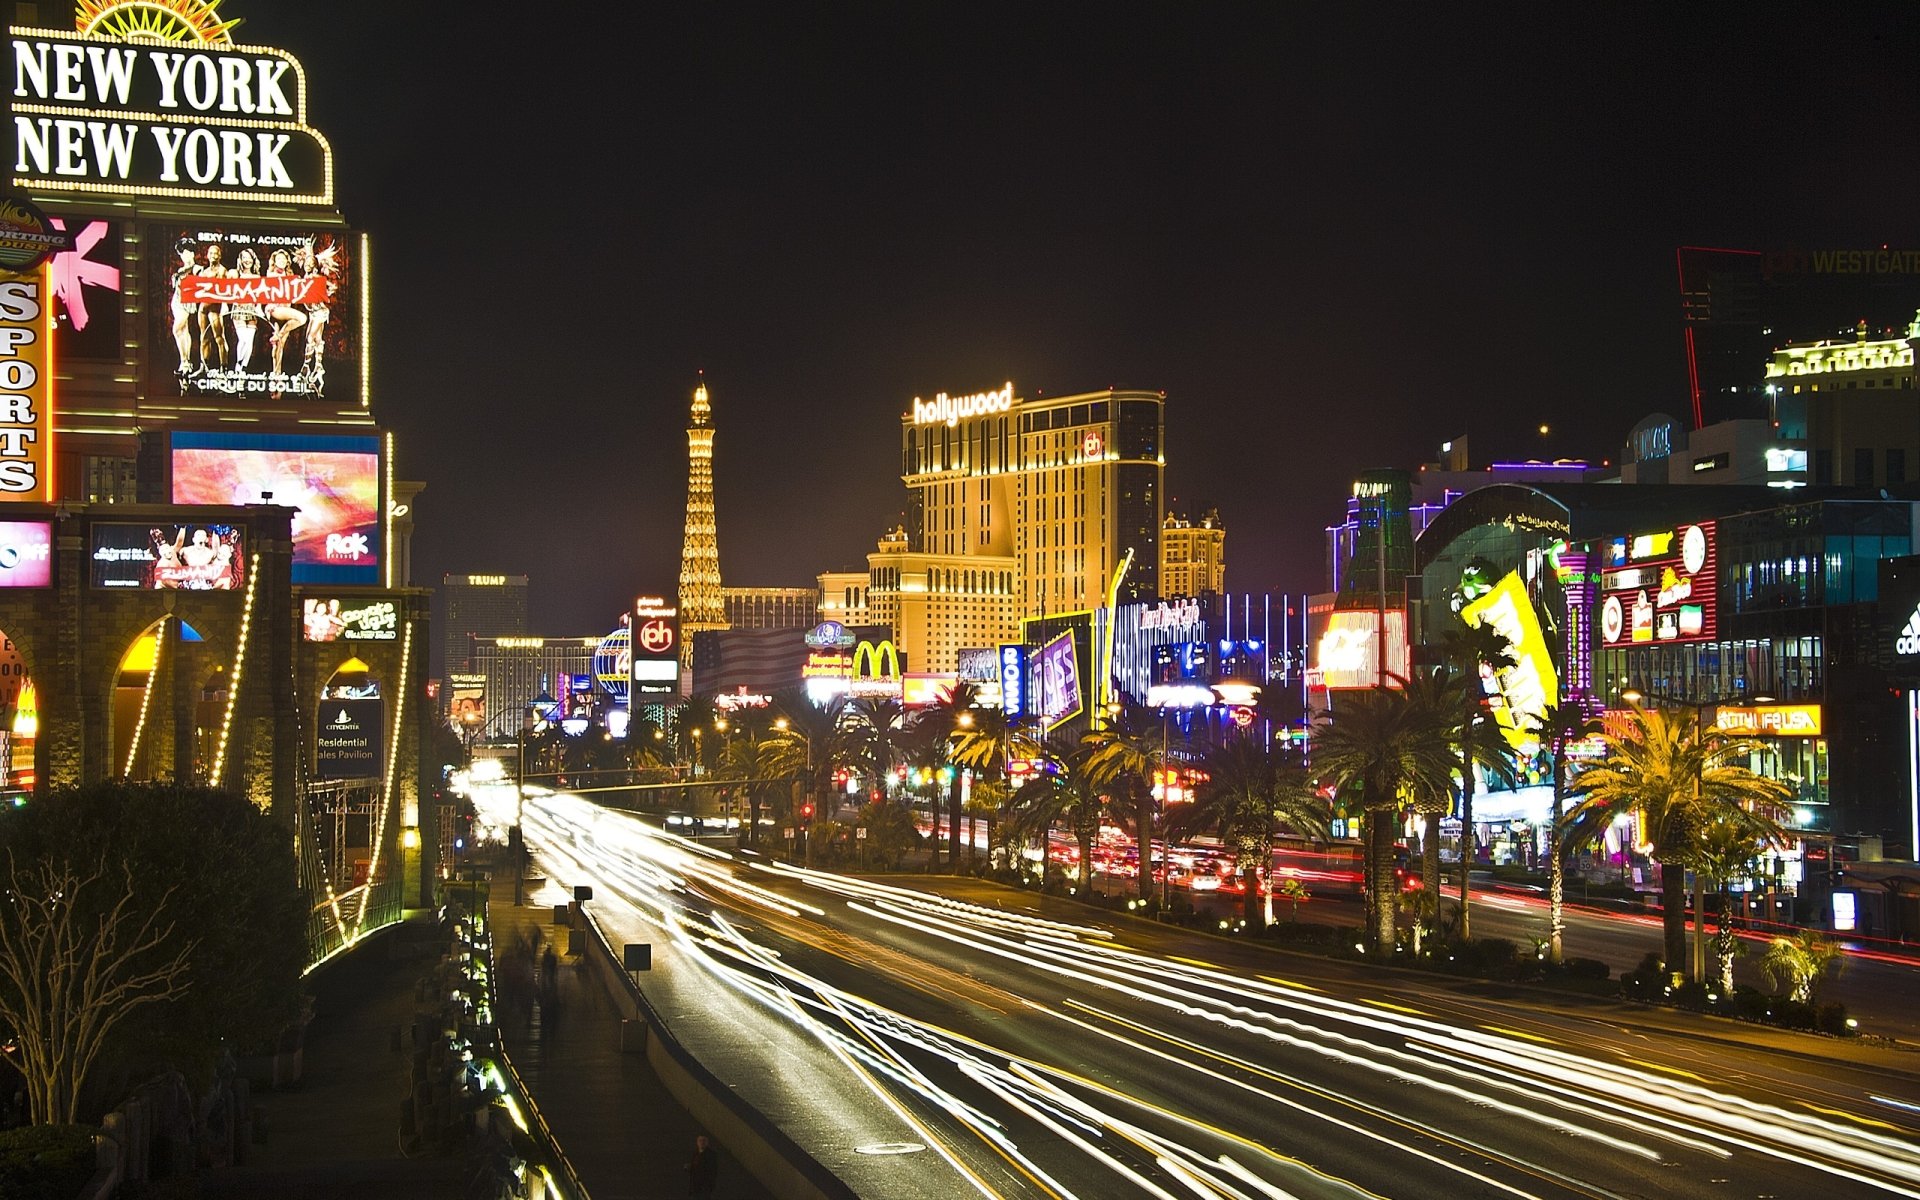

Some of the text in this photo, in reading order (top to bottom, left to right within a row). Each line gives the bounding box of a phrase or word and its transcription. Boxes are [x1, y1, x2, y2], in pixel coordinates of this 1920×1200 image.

[12, 40, 293, 116] NEW YORK
[14, 116, 294, 189] NEW YORK
[198, 232, 312, 246] SEXY FUN ACROBATIC
[194, 276, 314, 303] ZUMANITY
[0, 280, 38, 492] SPORTS
[197, 378, 245, 394] CIRQUE
[248, 381, 266, 392] DU
[914, 382, 1012, 427] hollywood
[468, 575, 505, 586] TRUMP
[644, 620, 672, 648] ph
[1896, 637, 1920, 655] adi
[318, 738, 368, 748] Residential
[318, 750, 373, 760] ales Pavilion
